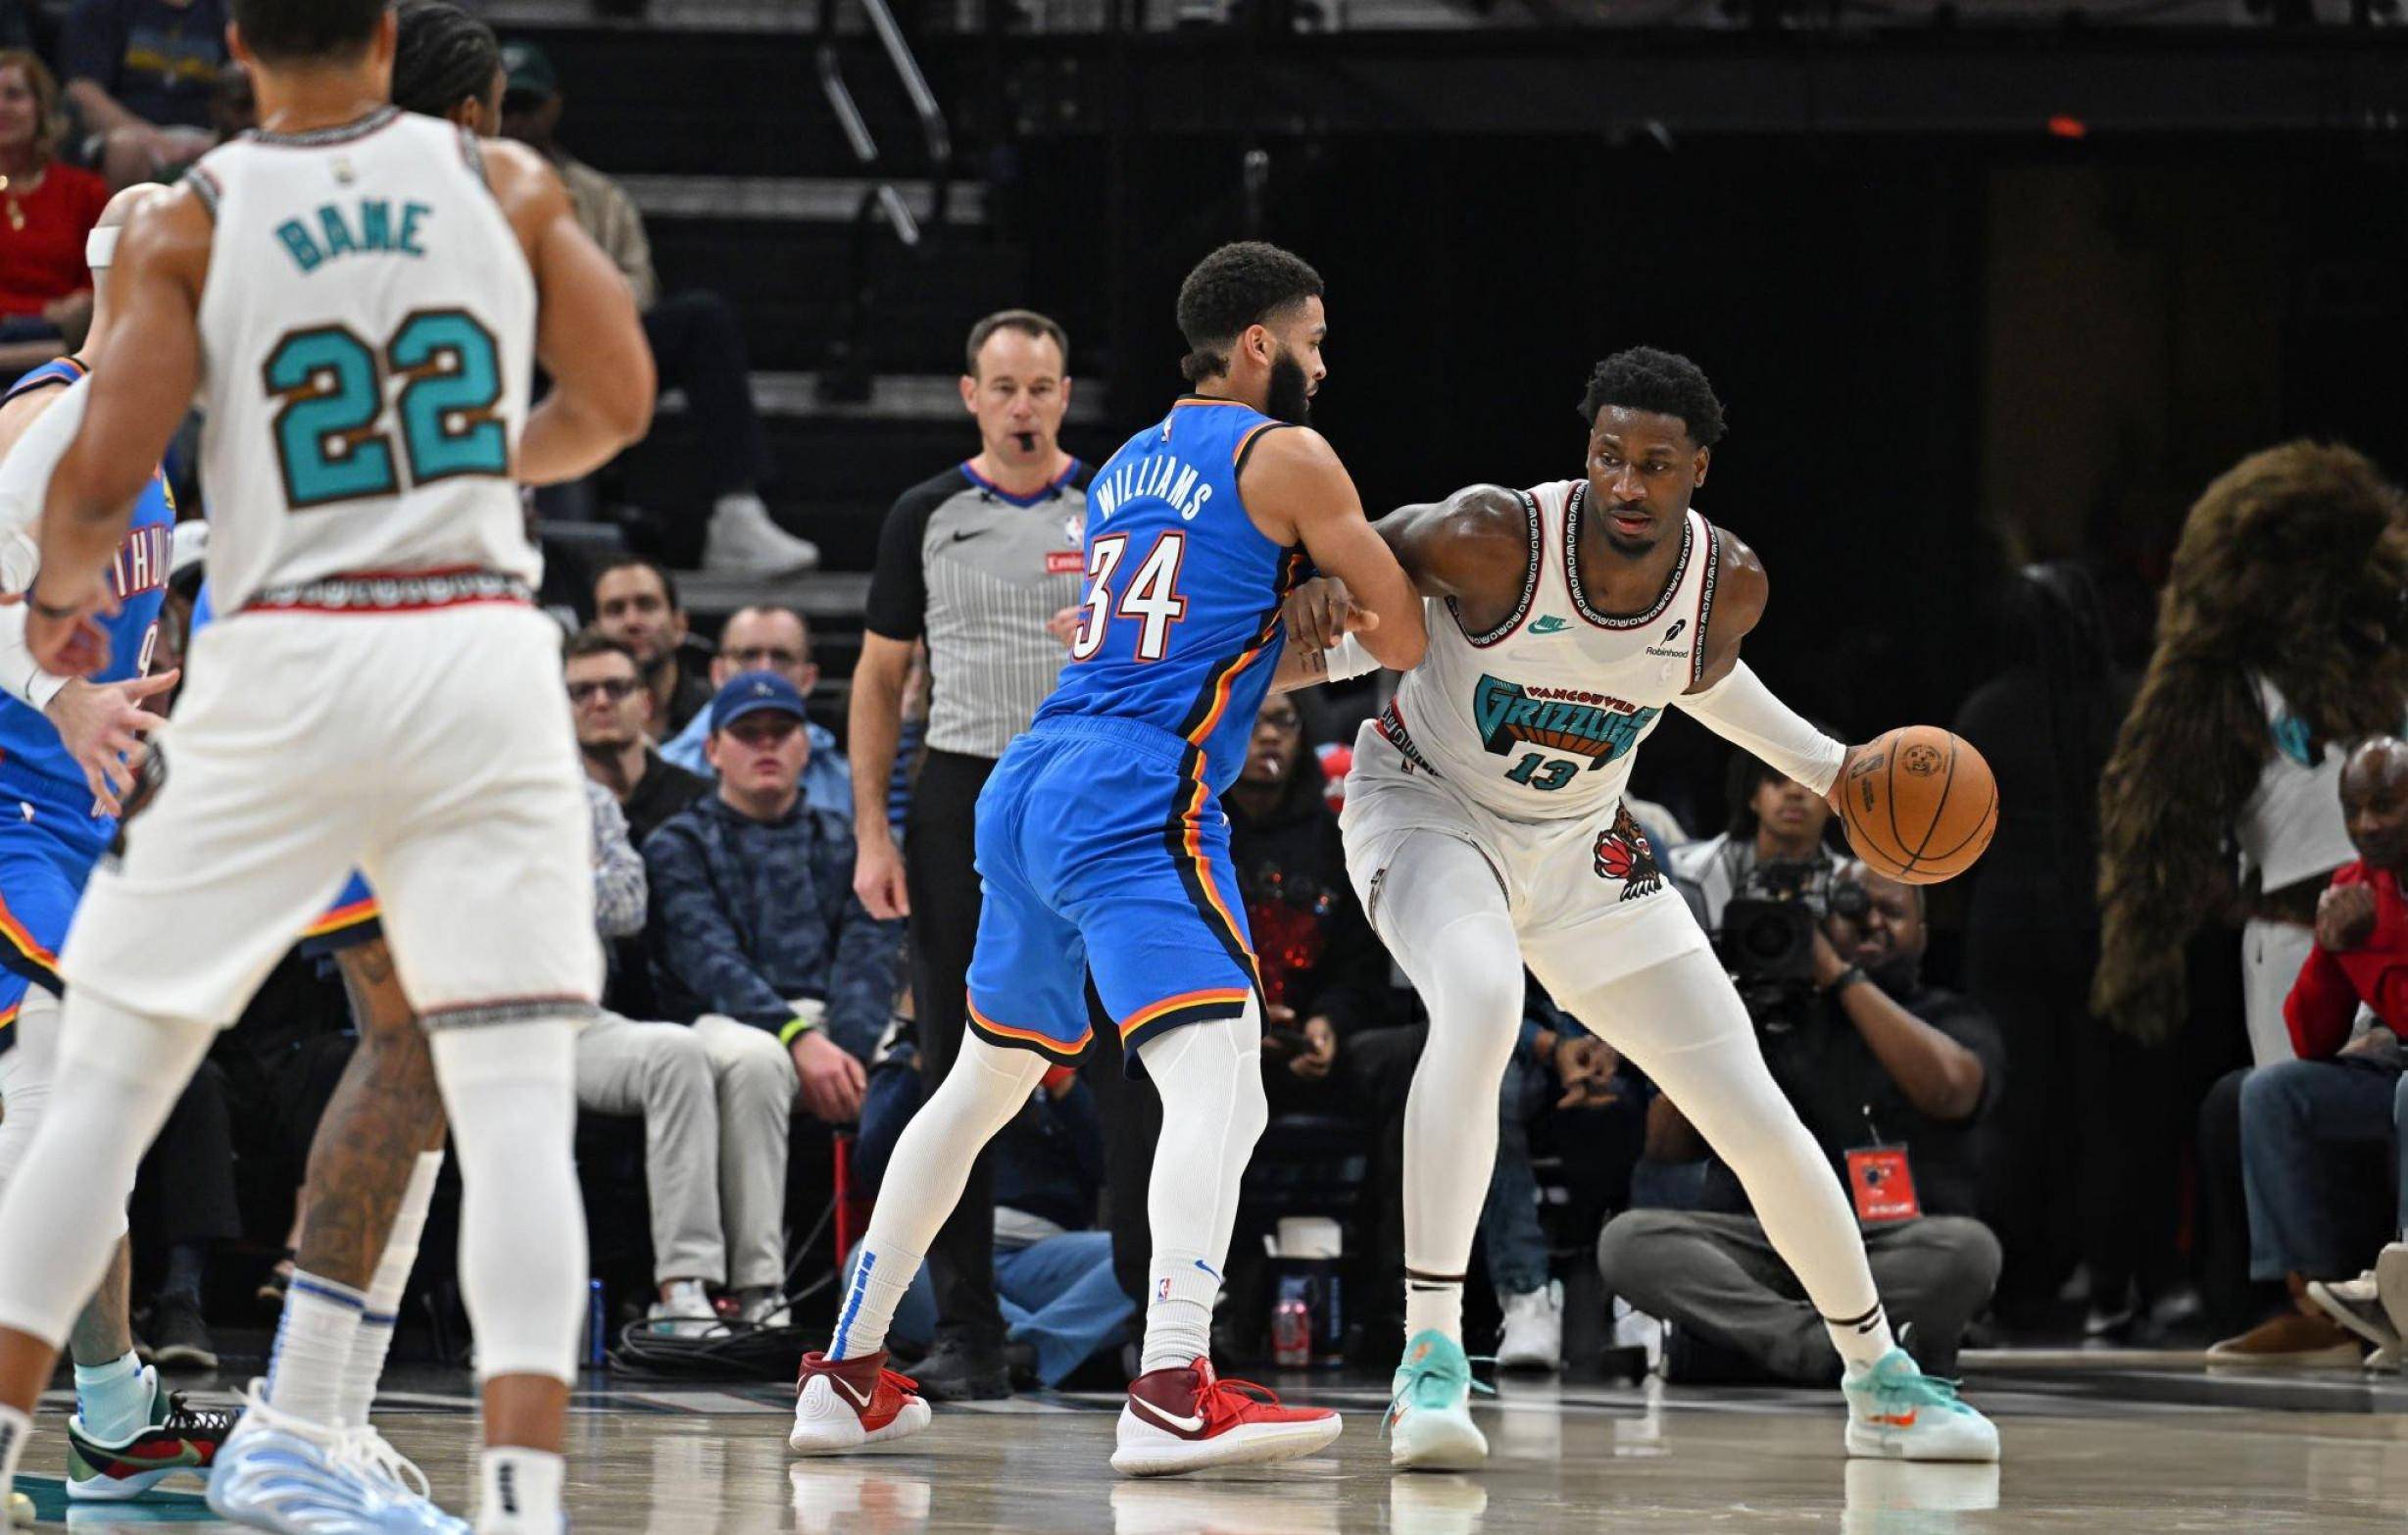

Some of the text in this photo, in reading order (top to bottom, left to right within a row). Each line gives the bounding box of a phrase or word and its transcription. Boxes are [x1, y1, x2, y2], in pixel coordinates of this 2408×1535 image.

[262, 307, 509, 512] 22
[1096, 455, 1212, 520] WILLIAMS
[1069, 529, 1189, 664] 34
[1646, 646, 1690, 659] Robinhood
[1473, 673, 1663, 769] GRIZZLIES
[1526, 686, 1636, 714] VANCOUVER
[1503, 752, 1580, 790] 13
